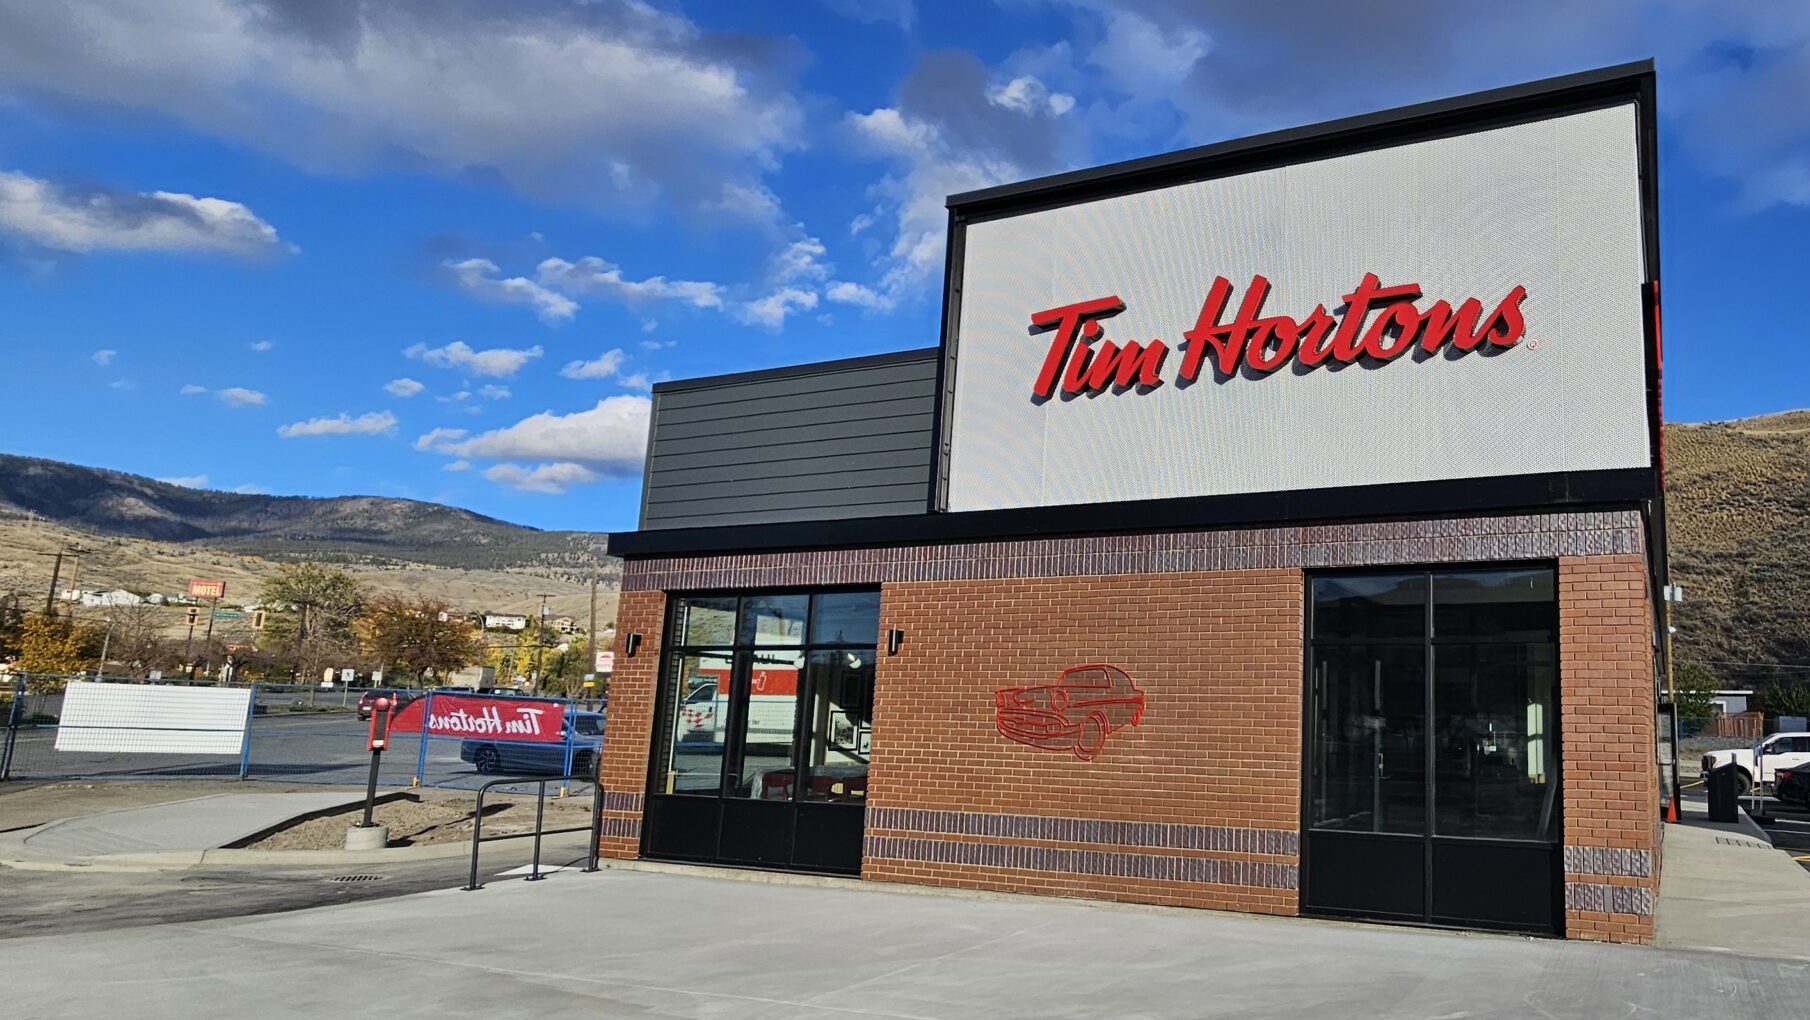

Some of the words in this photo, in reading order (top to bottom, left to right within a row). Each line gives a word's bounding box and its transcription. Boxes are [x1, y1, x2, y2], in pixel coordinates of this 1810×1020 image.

[1030, 295, 1169, 398] Tim
[1179, 272, 1527, 380] Hortons
[192, 585, 221, 596] MOTEL
